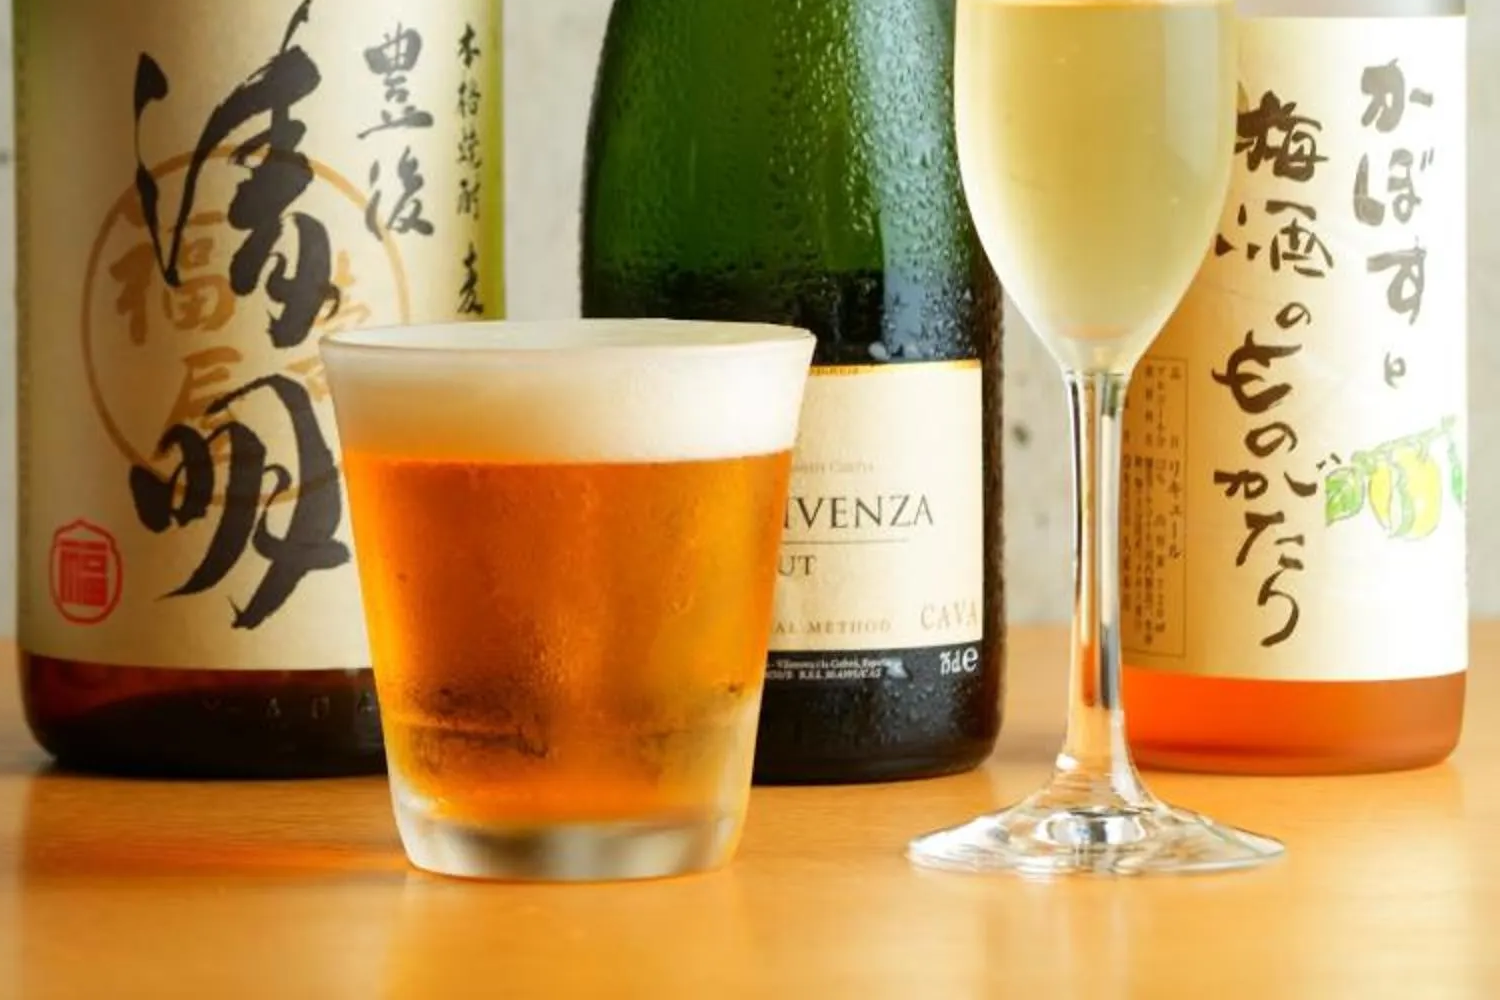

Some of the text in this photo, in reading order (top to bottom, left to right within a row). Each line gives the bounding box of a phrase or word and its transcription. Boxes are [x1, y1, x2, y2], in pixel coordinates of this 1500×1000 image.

[356, 22, 435, 241] 豊後
[782, 494, 935, 530] IVENZA
[807, 619, 892, 635] METHOD
[920, 601, 979, 631] CAVA
